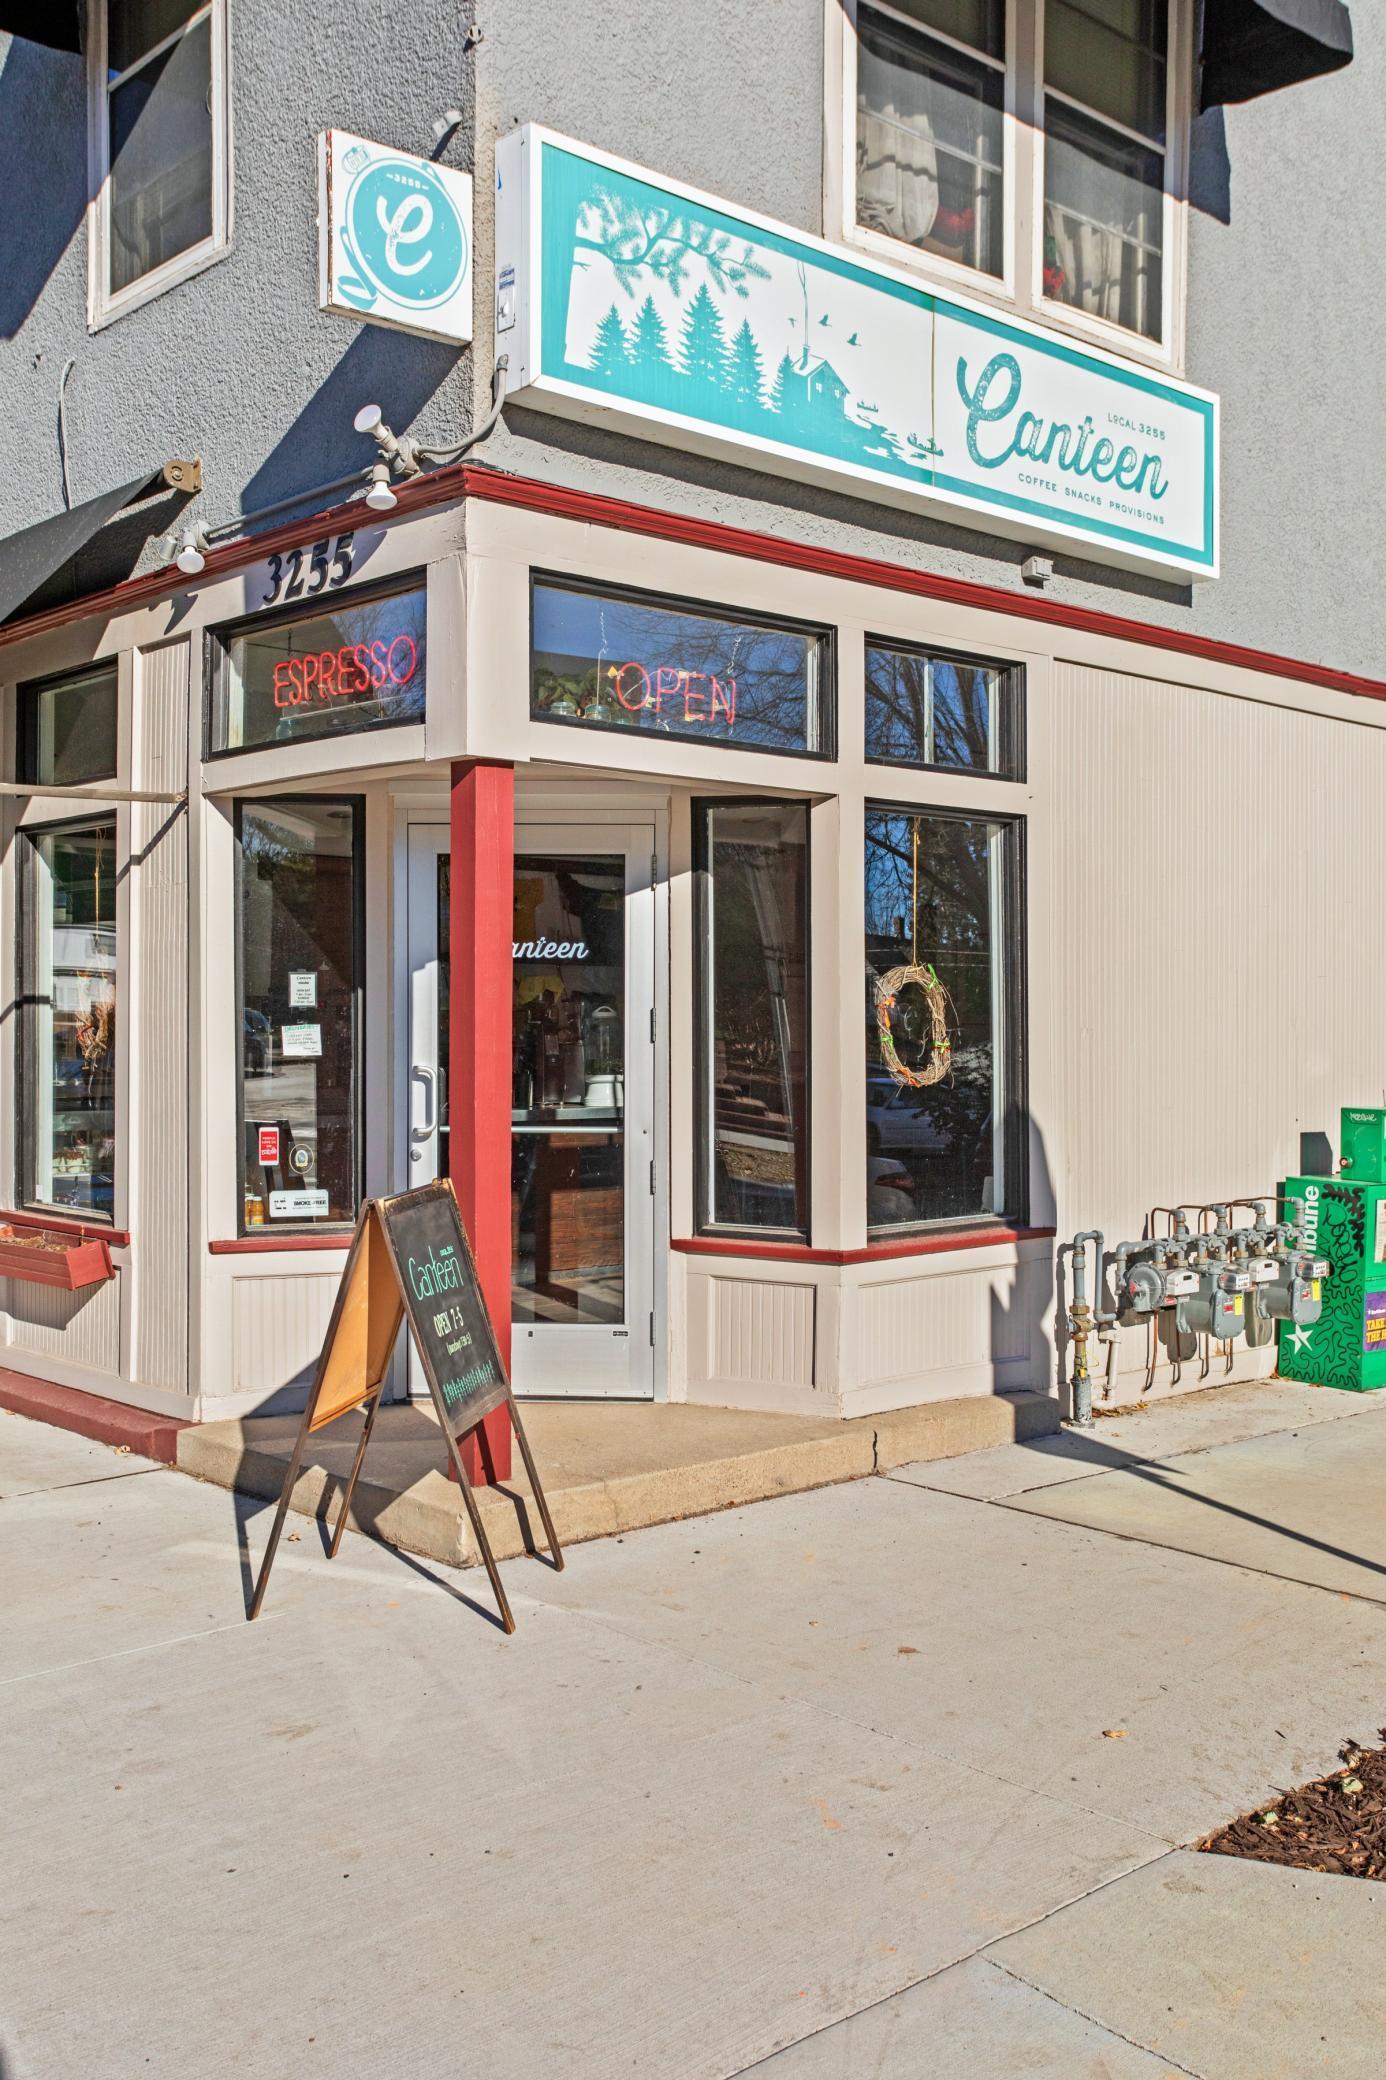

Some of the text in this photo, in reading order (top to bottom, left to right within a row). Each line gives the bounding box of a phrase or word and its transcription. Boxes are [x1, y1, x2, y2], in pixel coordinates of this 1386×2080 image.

[956, 353, 1169, 500] Canteen
[1108, 412, 1166, 440] LOCAL 3255
[1018, 473, 1165, 525] COFFEE SNACKS PROVISIONS
[262, 531, 354, 603] 3255
[273, 635, 417, 707] ESPRESSO
[616, 662, 736, 724] OPEN
[408, 1245, 464, 1301] Canteen
[433, 1311, 452, 1337] OPEN
